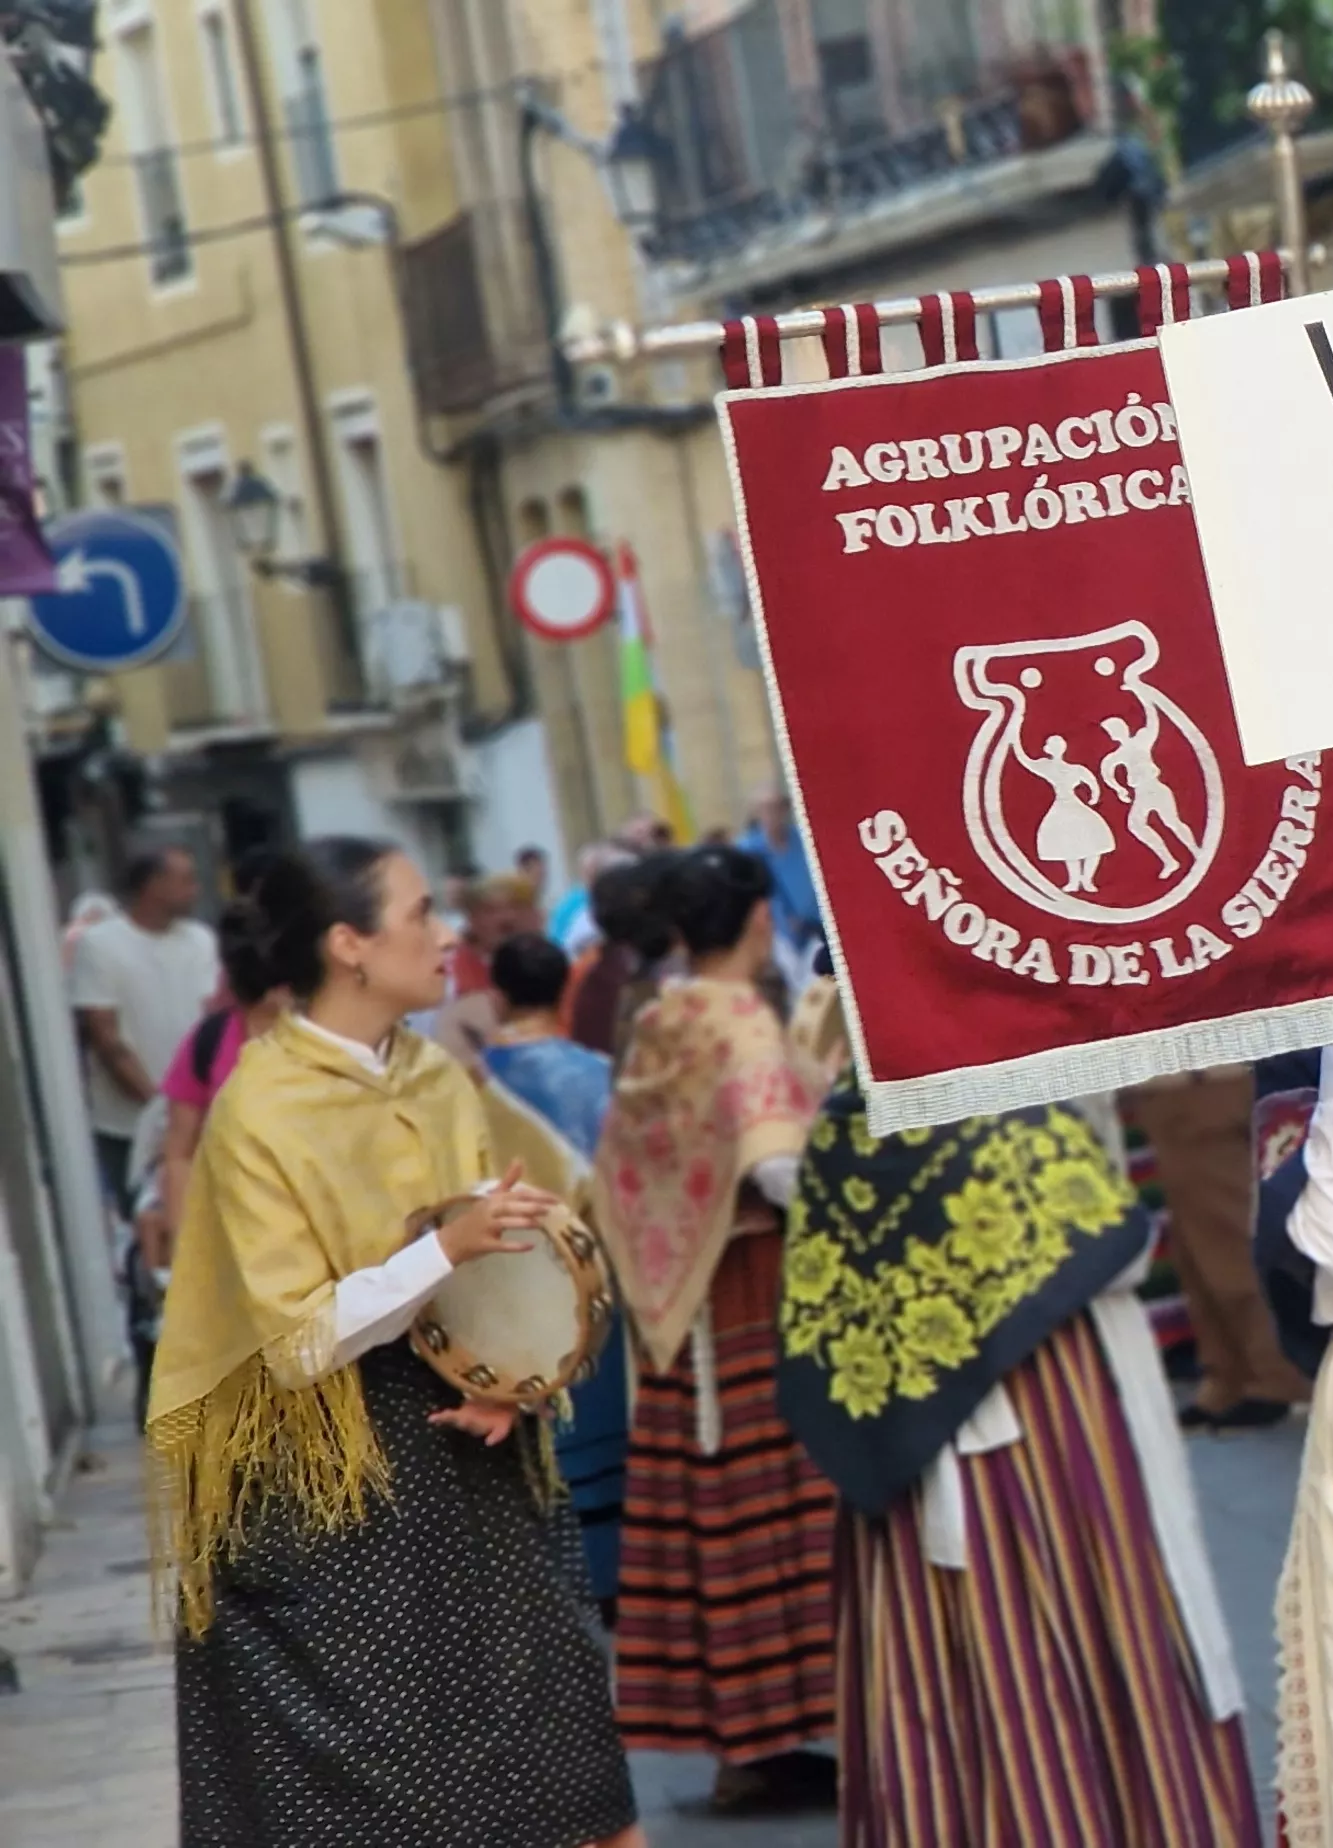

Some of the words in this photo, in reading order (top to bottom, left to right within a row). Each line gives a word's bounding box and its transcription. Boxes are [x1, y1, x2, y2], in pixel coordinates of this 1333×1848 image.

[835, 464, 1192, 554] FOLKLÓRICA
[857, 809, 1061, 986] SEÑORA
[1067, 941, 1150, 986] DE
[1149, 924, 1234, 978] LA
[1221, 750, 1322, 939] SIERRA
